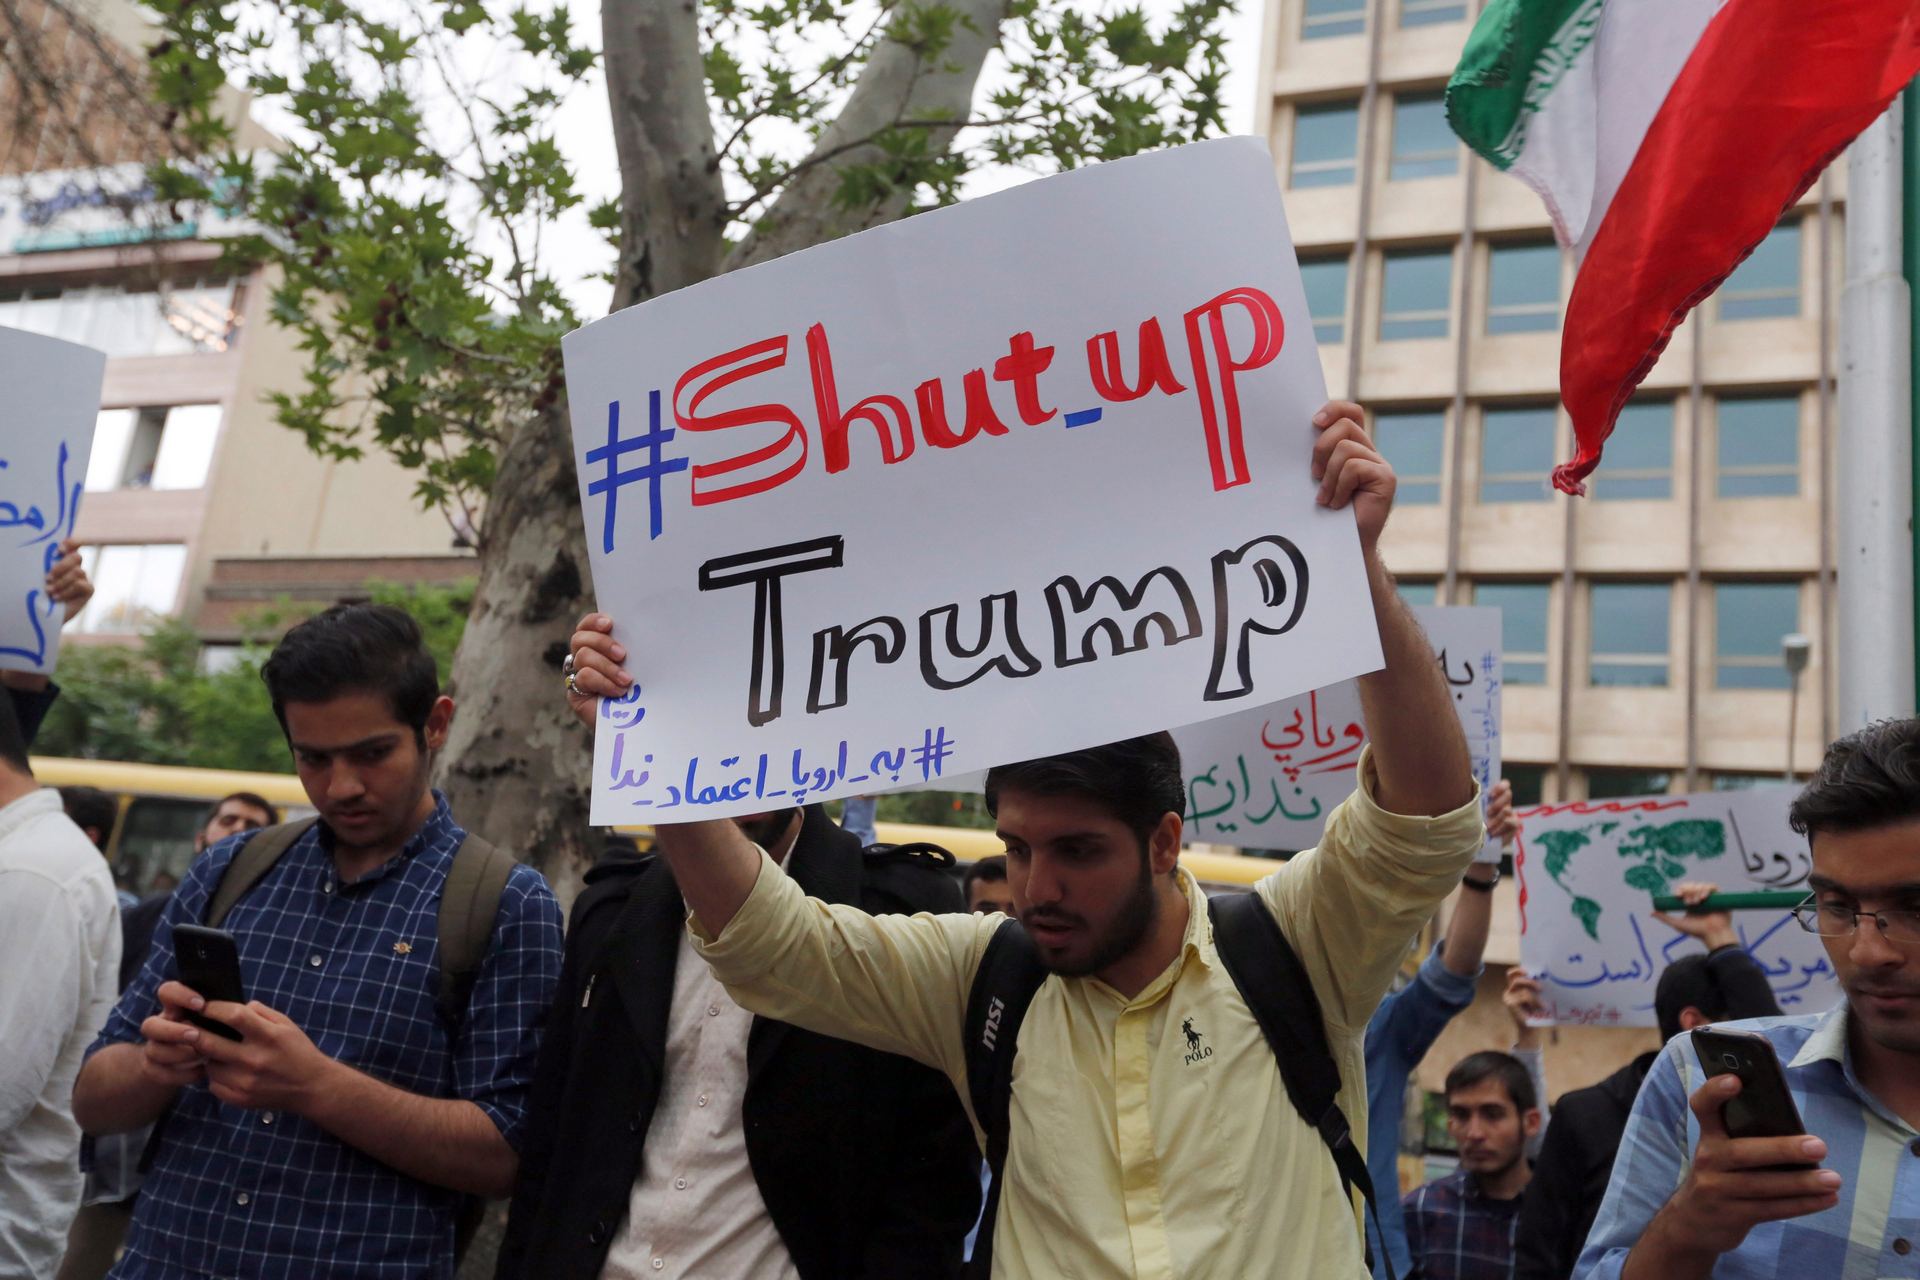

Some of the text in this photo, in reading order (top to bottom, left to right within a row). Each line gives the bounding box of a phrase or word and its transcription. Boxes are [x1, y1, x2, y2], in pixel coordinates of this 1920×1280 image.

[586, 287, 1285, 553] #Shut_up
[698, 535, 1310, 727] Trump
[982, 996, 1005, 1051] msi
[1184, 1046, 1213, 1066] POLO
